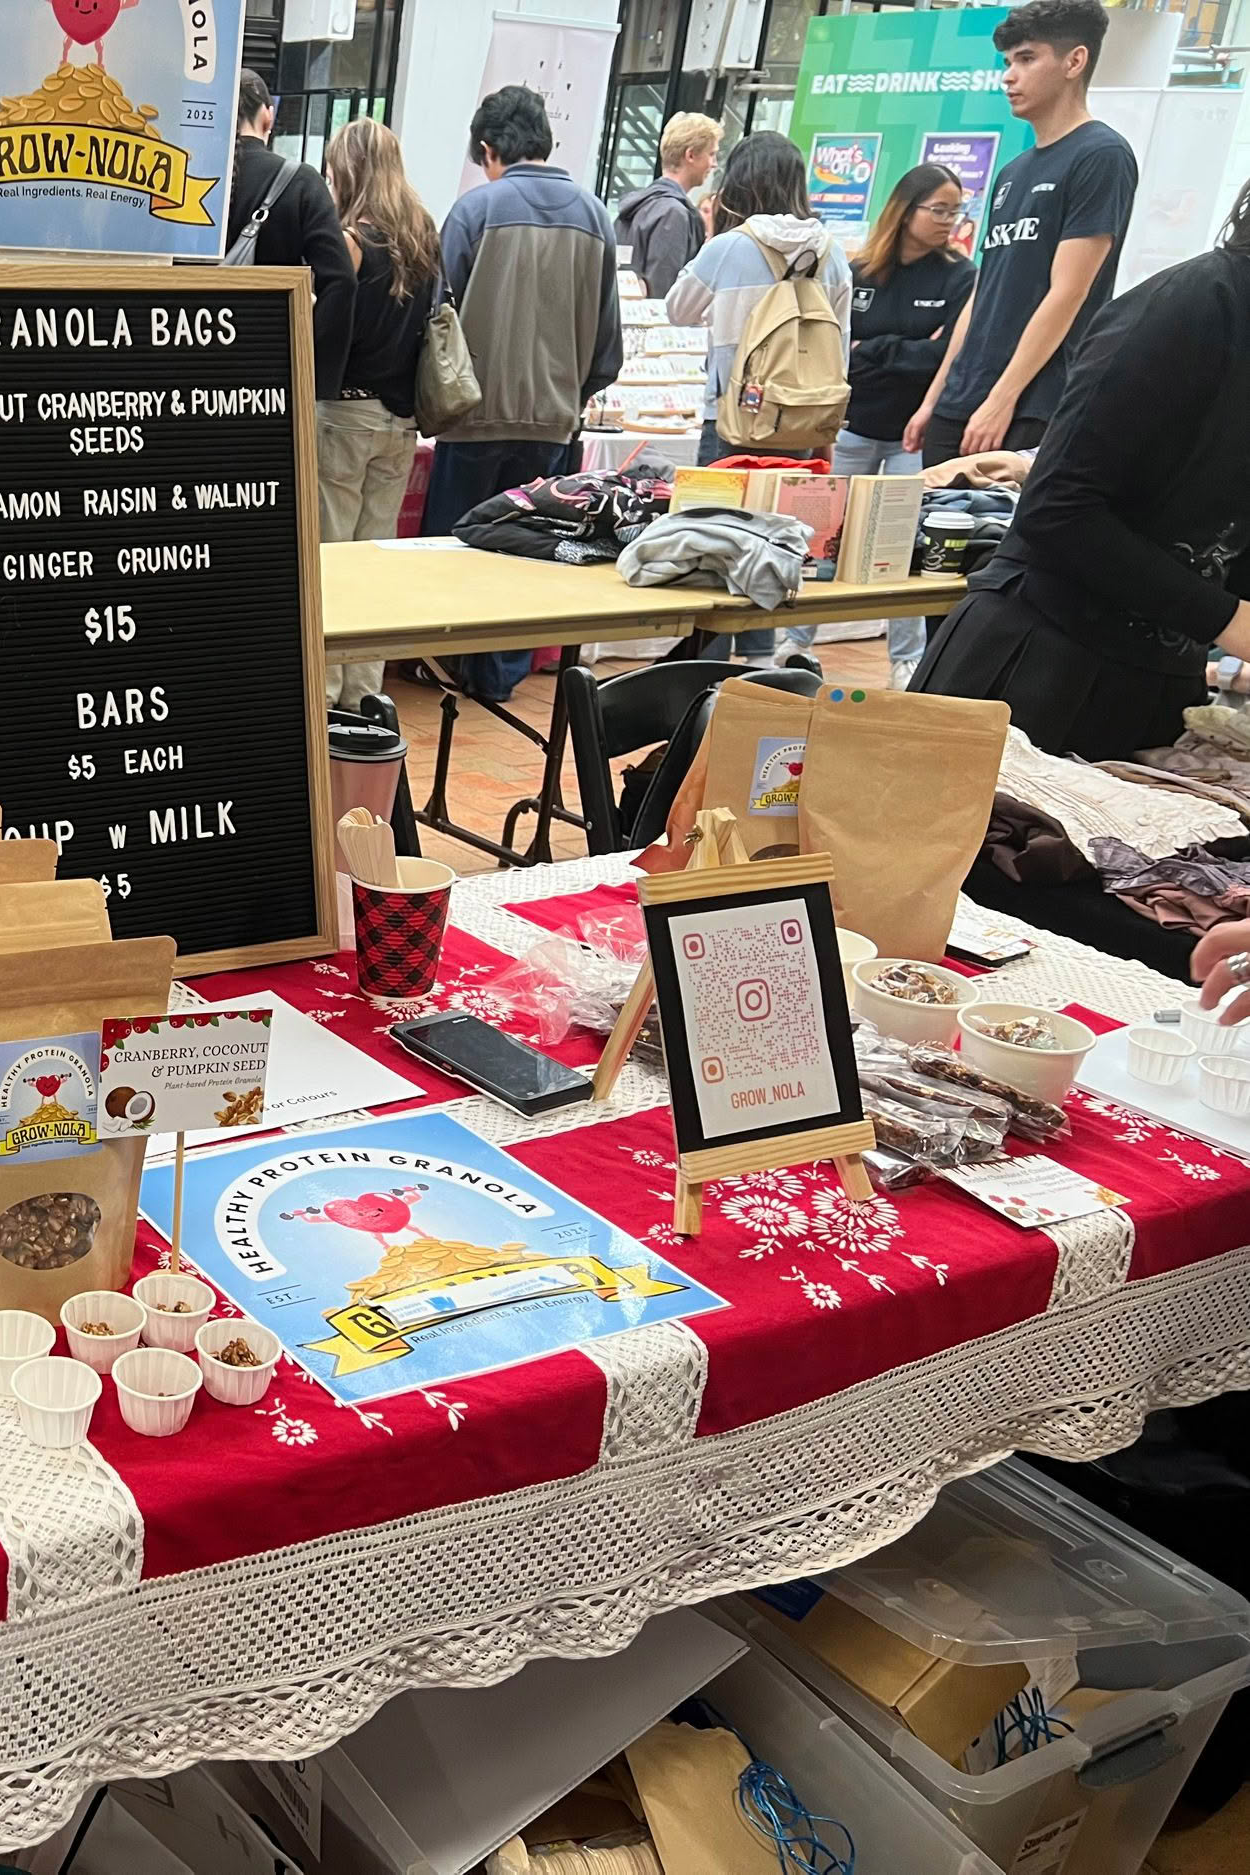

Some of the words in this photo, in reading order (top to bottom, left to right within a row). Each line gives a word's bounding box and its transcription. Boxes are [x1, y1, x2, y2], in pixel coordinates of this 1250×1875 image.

[812, 74, 847, 95] EAT
[874, 71, 941, 93] DRINK
[186, 109, 215, 121] 2025
[817, 144, 863, 163] What's
[831, 160, 850, 175] On
[21, 187, 83, 199] Ingredients.
[85, 189, 109, 201] Real
[110, 191, 147, 208] Energy.
[151, 307, 237, 347] BAGS
[37, 389, 165, 422] CRANBERRY
[171, 389, 185, 417] &
[191, 387, 286, 417] PUMPKIN
[69, 426, 144, 455] SEEDS
[84, 486, 156, 517] RAISIN
[172, 485, 187, 510] &
[195, 481, 279, 510] WALNUT
[3, 551, 93, 581] GINGER
[117, 544, 210, 575] CRUNCH
[84, 605, 136, 645] $15
[77, 686, 169, 729] BARS
[68, 754, 96, 780] $5
[124, 745, 183, 775] EACH
[150, 801, 237, 845] MILK
[100, 874, 131, 899] $5
[114, 1048, 199, 1063] CRANBERRY,
[203, 1042, 269, 1058] COCONUT
[1, 1064, 22, 1108] HEALTHY
[24, 1049, 66, 1064] PROTEIN
[68, 1055, 94, 1096] GRANOLA
[151, 1065, 164, 1078] &
[167, 1061, 230, 1077] PUMPKIN
[232, 1059, 266, 1071] SEED
[164, 1081, 206, 1090] Plant-based
[208, 1078, 233, 1087] Protein
[234, 1076, 262, 1086] Granola
[731, 1081, 805, 1109] GROW_NOLA
[271, 1102, 285, 1110] or
[287, 1089, 338, 1107] Colours
[12, 1122, 86, 1145] GROW-NOLA
[248, 1151, 370, 1188] PROTEIN
[388, 1154, 538, 1215] GRANOLA
[226, 1190, 274, 1274] HEALTHY
[554, 1225, 590, 1240] 2025
[265, 1291, 300, 1304] EST.
[410, 1329, 442, 1345] Real
[513, 1301, 542, 1315] Real
